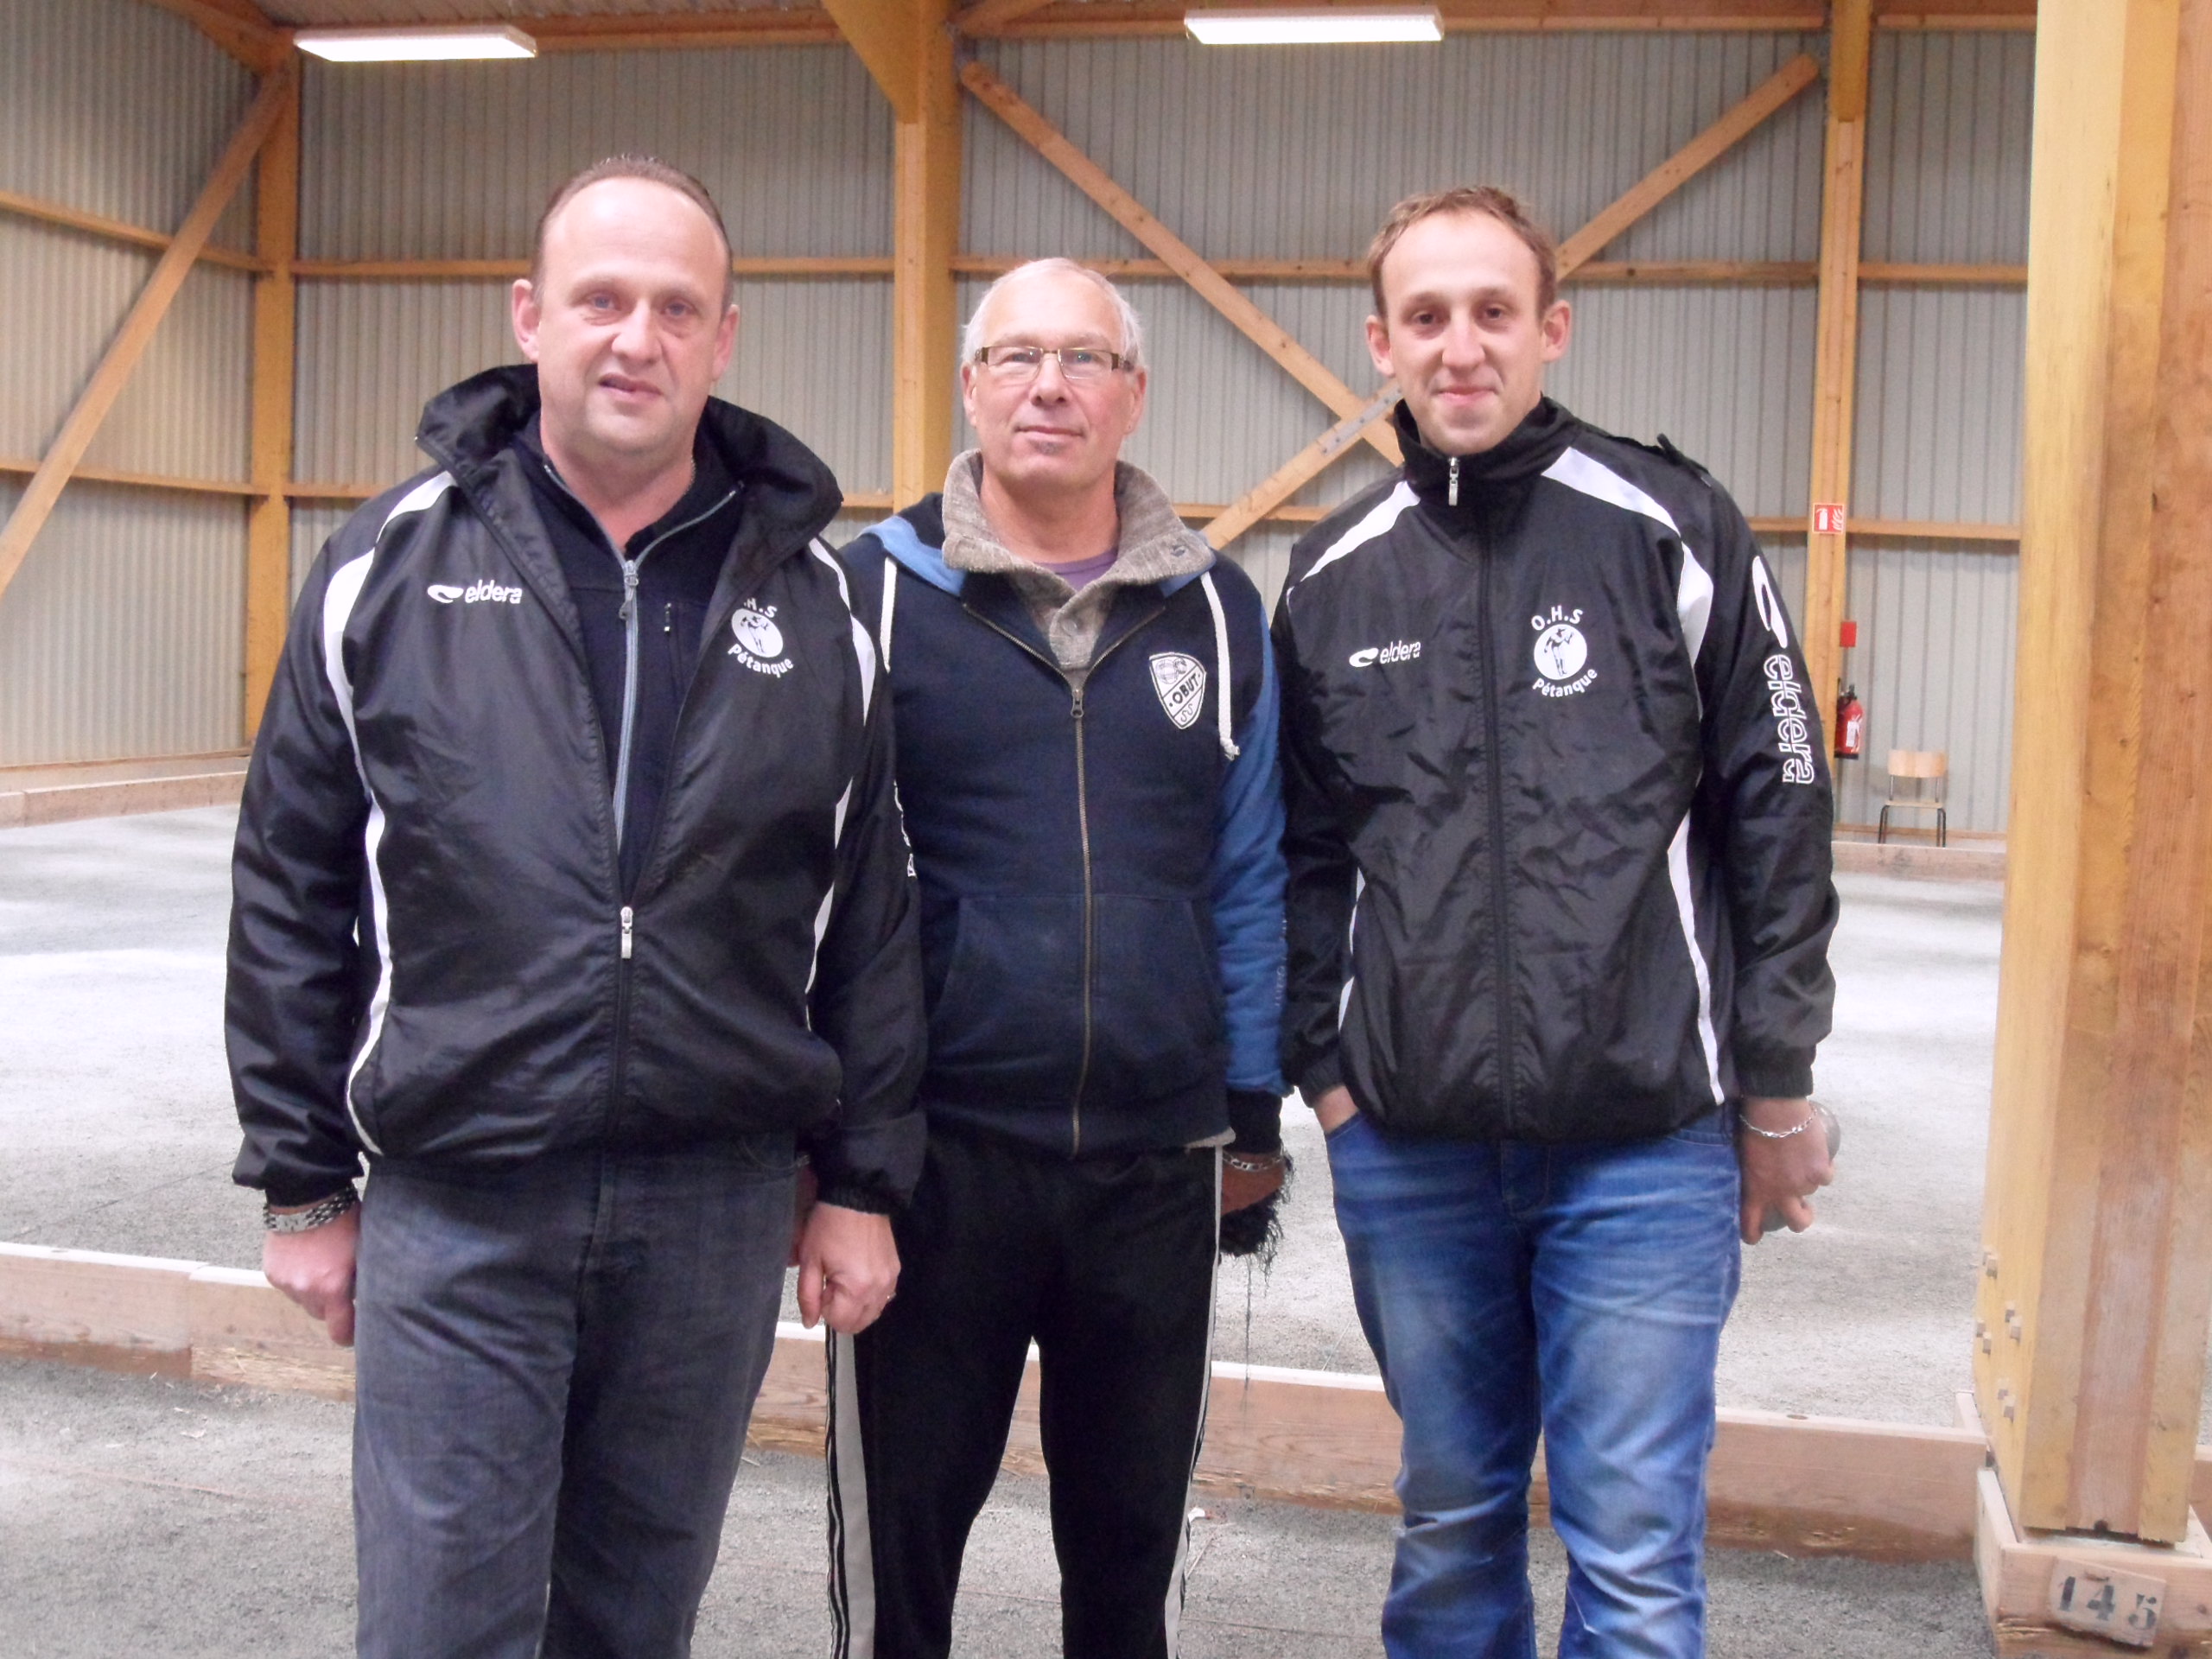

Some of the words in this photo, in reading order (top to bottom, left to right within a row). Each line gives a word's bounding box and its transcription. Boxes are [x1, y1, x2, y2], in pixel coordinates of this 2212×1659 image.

[465, 579, 523, 604] eldera
[743, 597, 778, 619] .H.S
[1530, 604, 1584, 631] O.H.S
[728, 643, 794, 678] Pétanque
[1380, 639, 1421, 664] eldera
[1532, 668, 1598, 697] Pétanque
[1764, 653, 1815, 785] eldera
[2059, 1575, 2158, 1630] 145
